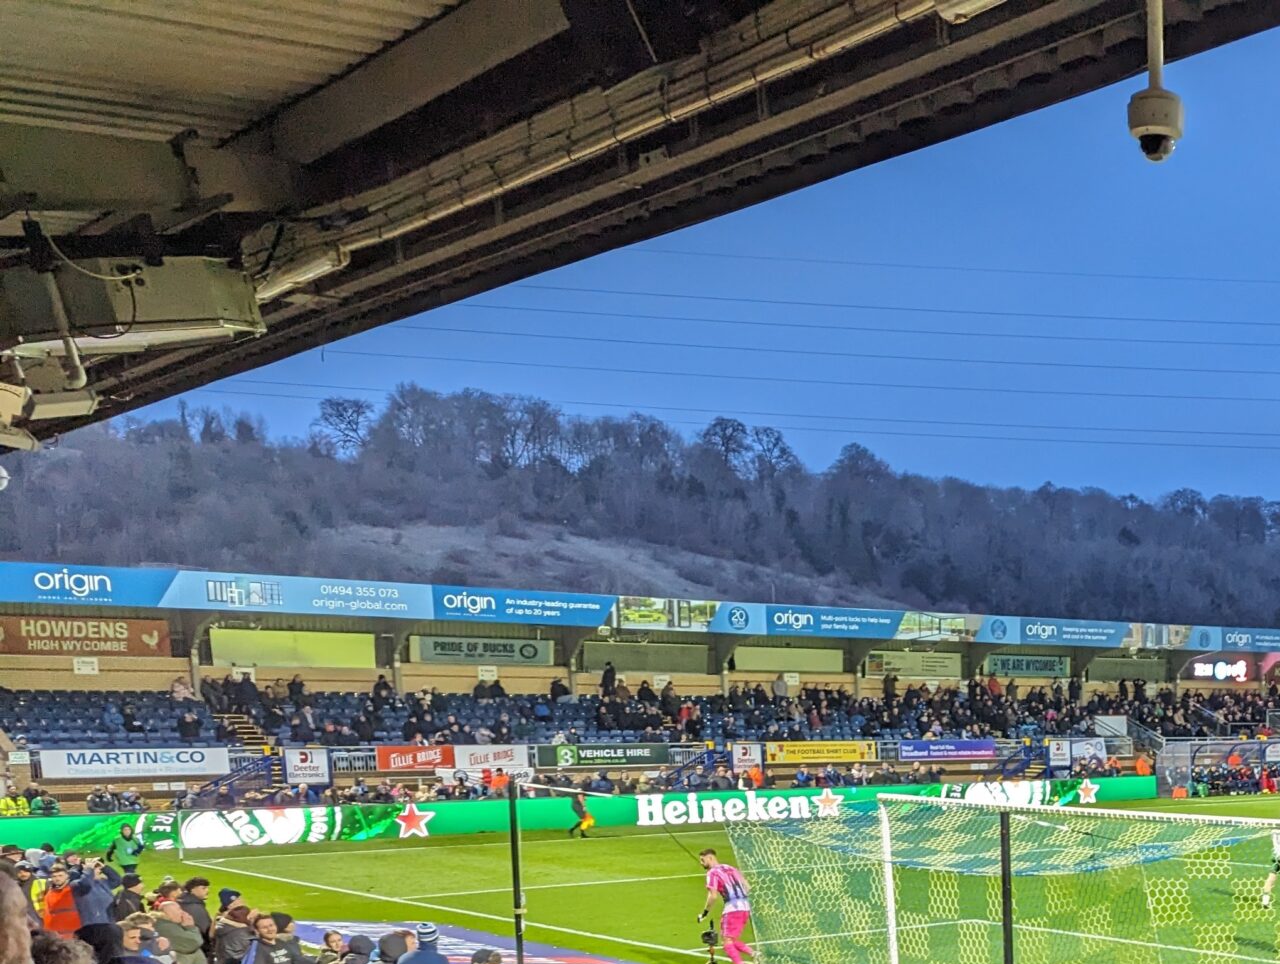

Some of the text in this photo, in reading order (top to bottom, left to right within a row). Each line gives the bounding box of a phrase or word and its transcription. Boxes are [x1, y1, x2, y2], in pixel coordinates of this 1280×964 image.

[34, 568, 112, 596] origin
[320, 585, 399, 598] 01494 355 073
[312, 598, 408, 611] origin-global.com
[443, 591, 496, 613] origin
[774, 609, 813, 628] origin
[20, 619, 128, 638] HOWDENS
[1026, 622, 1057, 638] origin
[27, 640, 128, 652] HIGH WYCOMBE
[433, 641, 515, 654] PRIDE OF BUCKS
[1225, 631, 1251, 647] origin
[560, 748, 651, 766] 3 VEHICLE HIRE
[634, 790, 811, 826] Heineken
